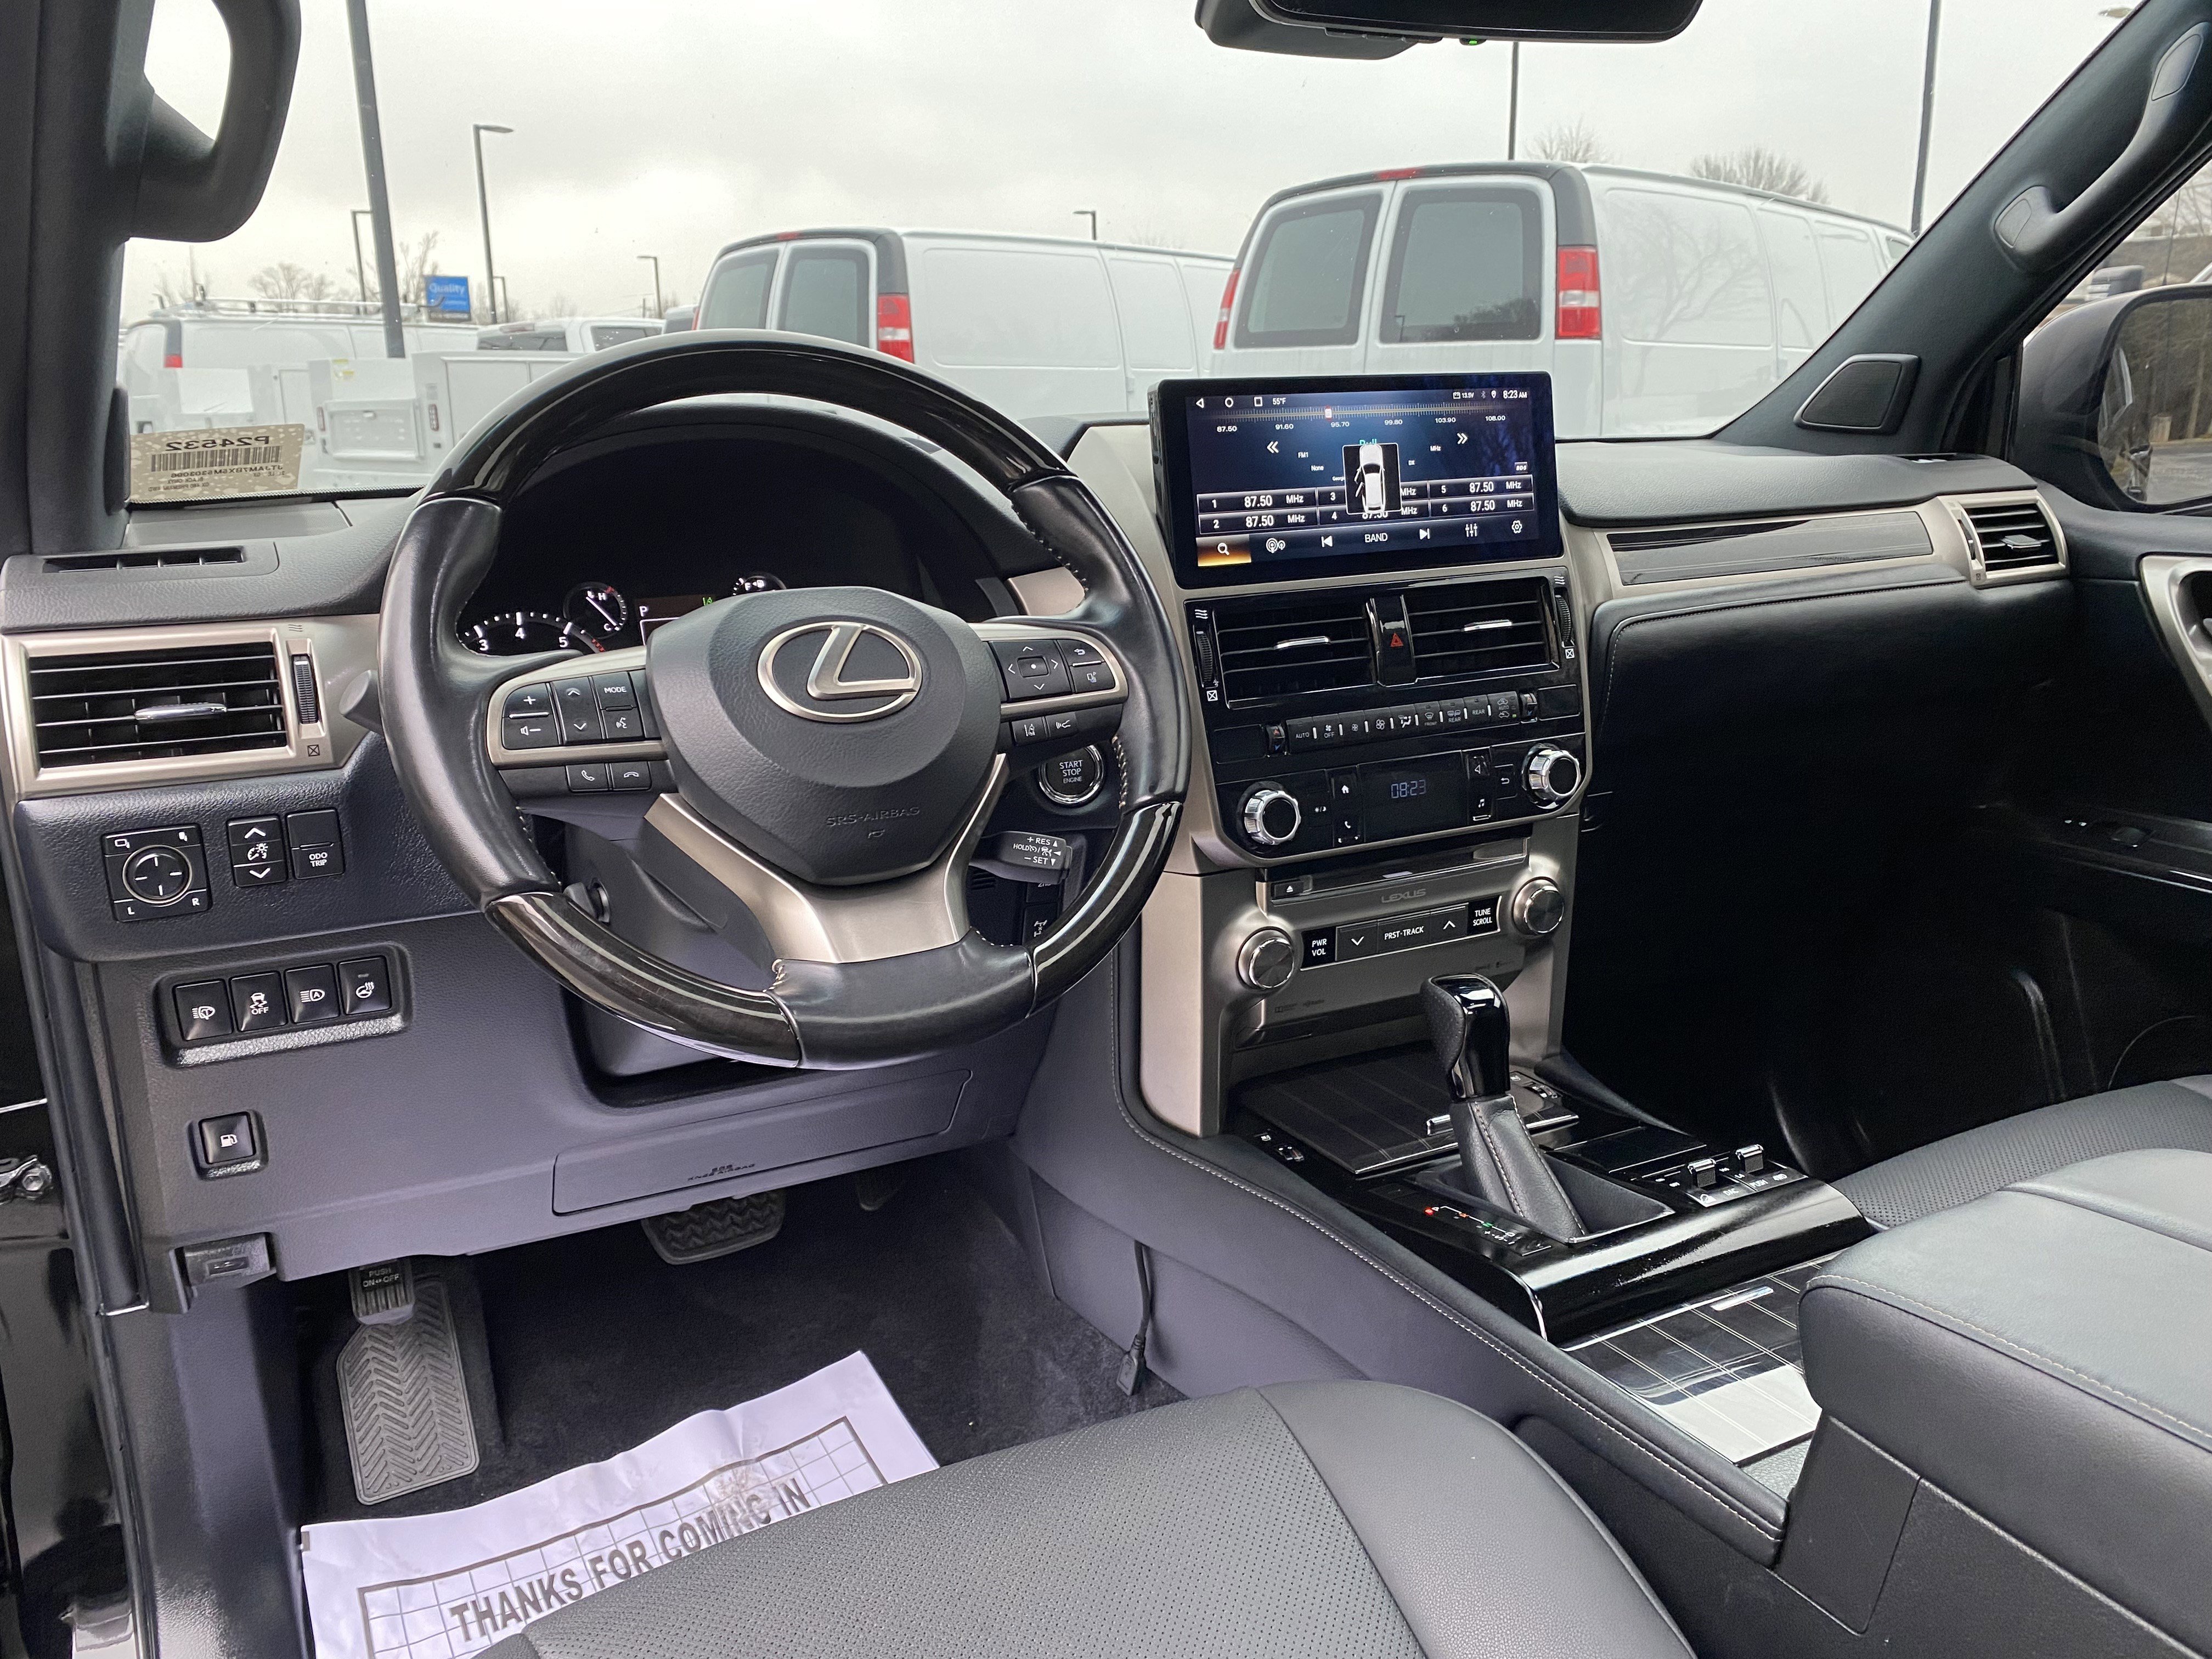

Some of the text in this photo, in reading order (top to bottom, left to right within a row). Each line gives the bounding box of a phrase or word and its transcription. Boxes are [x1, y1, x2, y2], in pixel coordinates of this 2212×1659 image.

[428, 283, 465, 294] Quality
[1503, 390, 1518, 399] 8:23
[1272, 397, 1286, 405] 55°F
[1441, 481, 1521, 493] 5 87.50 MHz
[1330, 487, 1417, 501] 3 MHz
[1211, 494, 1304, 508] 1 87.50 MHz
[1442, 499, 1522, 512] 6 87.50 MHz
[1331, 511, 1337, 520] 4
[1401, 506, 1418, 515] MHz
[1213, 515, 1305, 529] 2 87.50 MHz
[1364, 533, 1388, 543] BAND
[598, 592, 606, 601] H
[639, 606, 648, 617] P
[515, 628, 525, 639] 4
[478, 639, 489, 651] 3
[558, 636, 568, 647] 5
[604, 686, 627, 694] MODE
[1059, 759, 1083, 769] START
[1062, 768, 1081, 777] STOP
[1391, 780, 1426, 799] 08:23
[1035, 837, 1051, 845] RES
[1013, 843, 1030, 851] HOLD
[309, 852, 328, 861] ODO
[1032, 856, 1048, 865] SET
[310, 859, 328, 867] TRIP
[1381, 888, 1426, 903] LEXUS
[191, 898, 200, 906] R
[127, 906, 135, 915] L
[1475, 907, 1491, 917] TUNE
[1472, 917, 1493, 927] SCROLL
[1312, 938, 1327, 948] PWR
[1312, 948, 1326, 957] VOL
[251, 1007, 269, 1015] OFF
[369, 1267, 392, 1278] PUSH
[449, 1477, 811, 1642] THANKS FOR COMING IN
